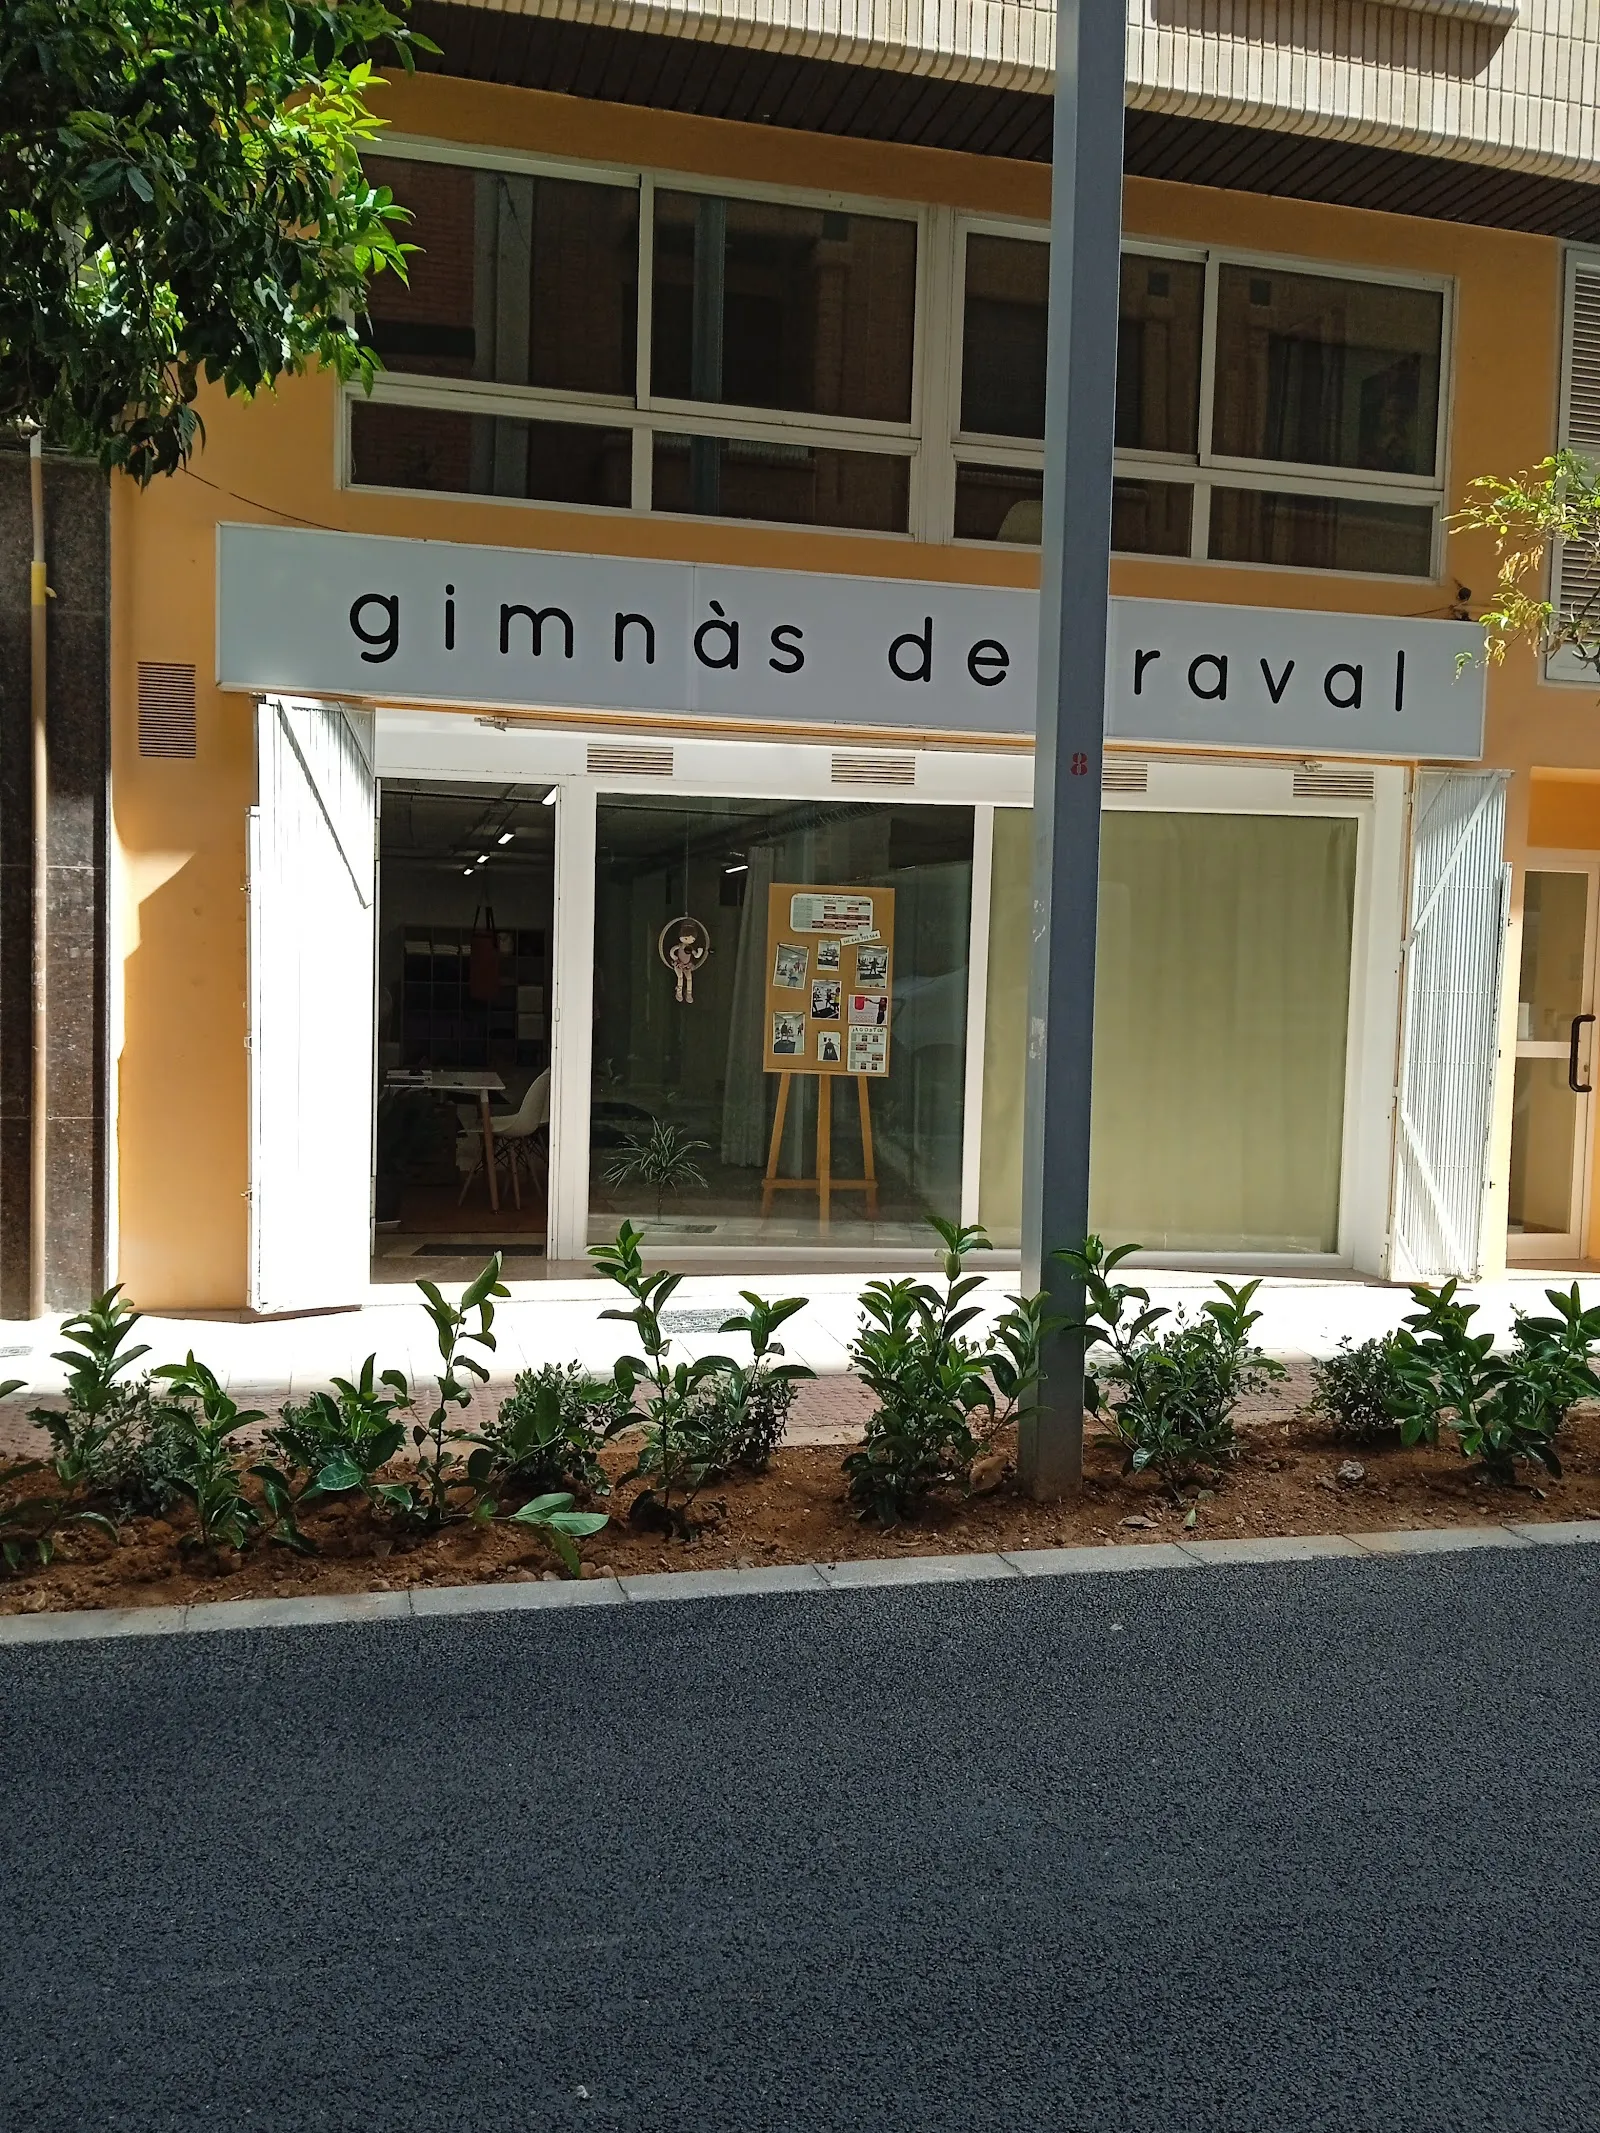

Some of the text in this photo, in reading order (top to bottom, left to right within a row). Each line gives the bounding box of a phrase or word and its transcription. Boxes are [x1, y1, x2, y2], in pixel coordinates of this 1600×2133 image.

[349, 583, 1405, 712] gimnàs de raval
[1070, 752, 1088, 776] 8
